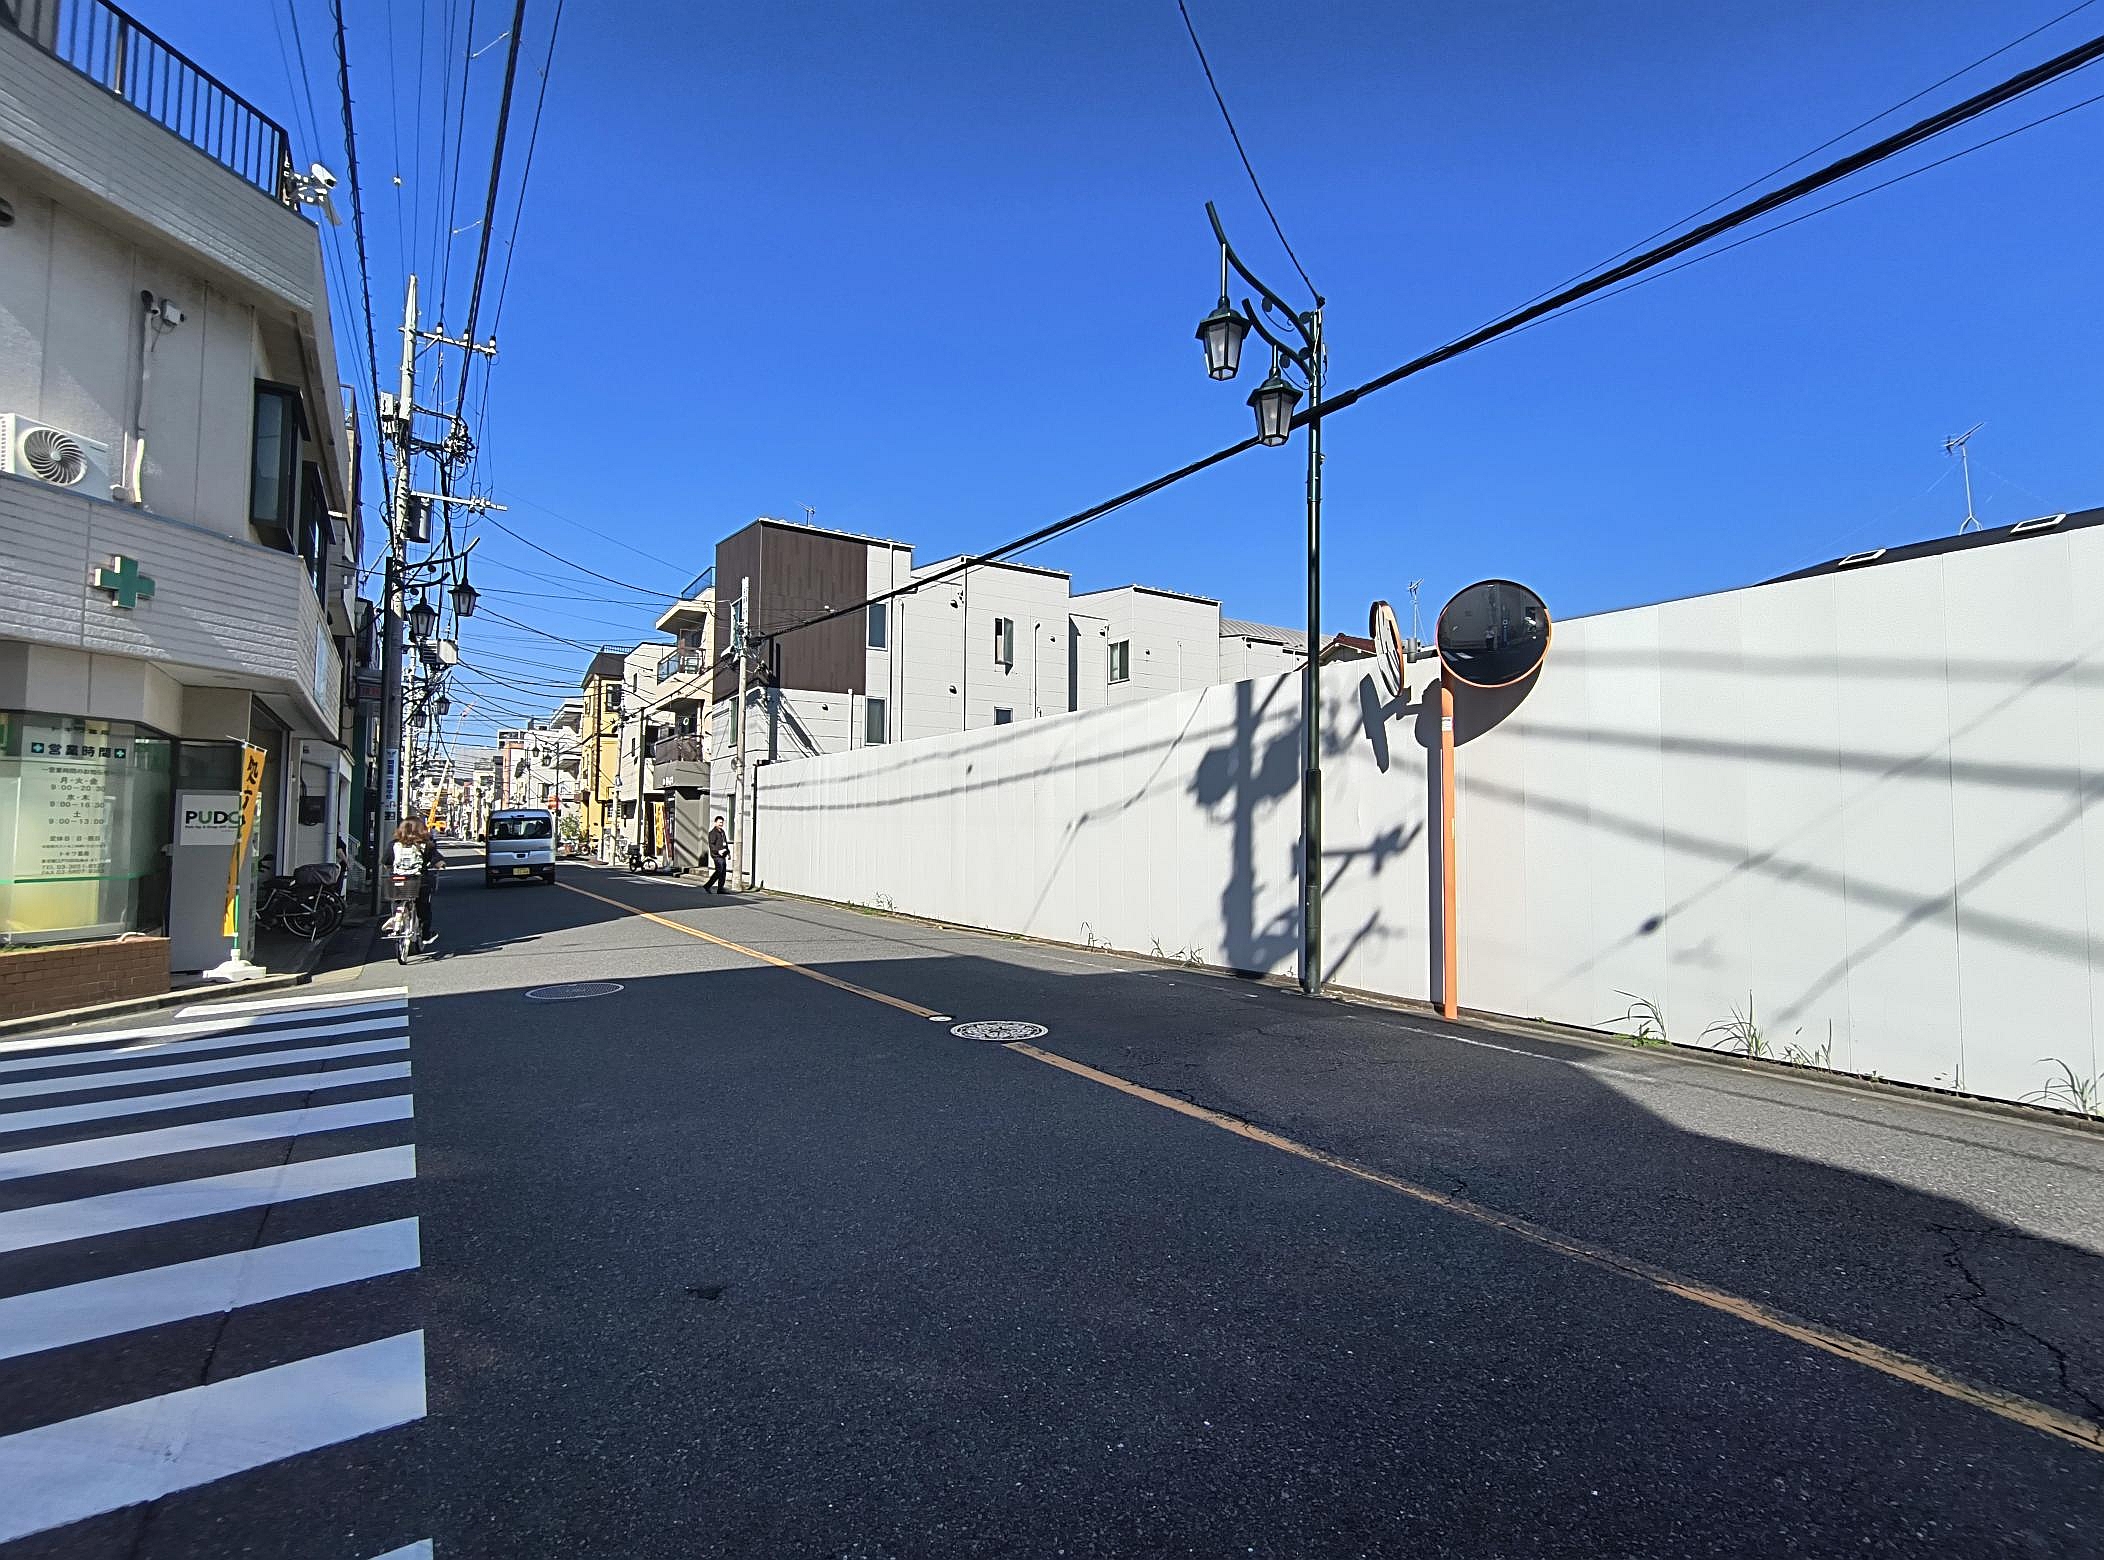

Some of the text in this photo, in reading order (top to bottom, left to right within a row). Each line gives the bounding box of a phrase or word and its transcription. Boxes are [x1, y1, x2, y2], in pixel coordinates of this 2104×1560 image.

[48, 743, 112, 758] 営業時間
[73, 810, 82, 818] 土
[185, 810, 240, 825] PUDO
